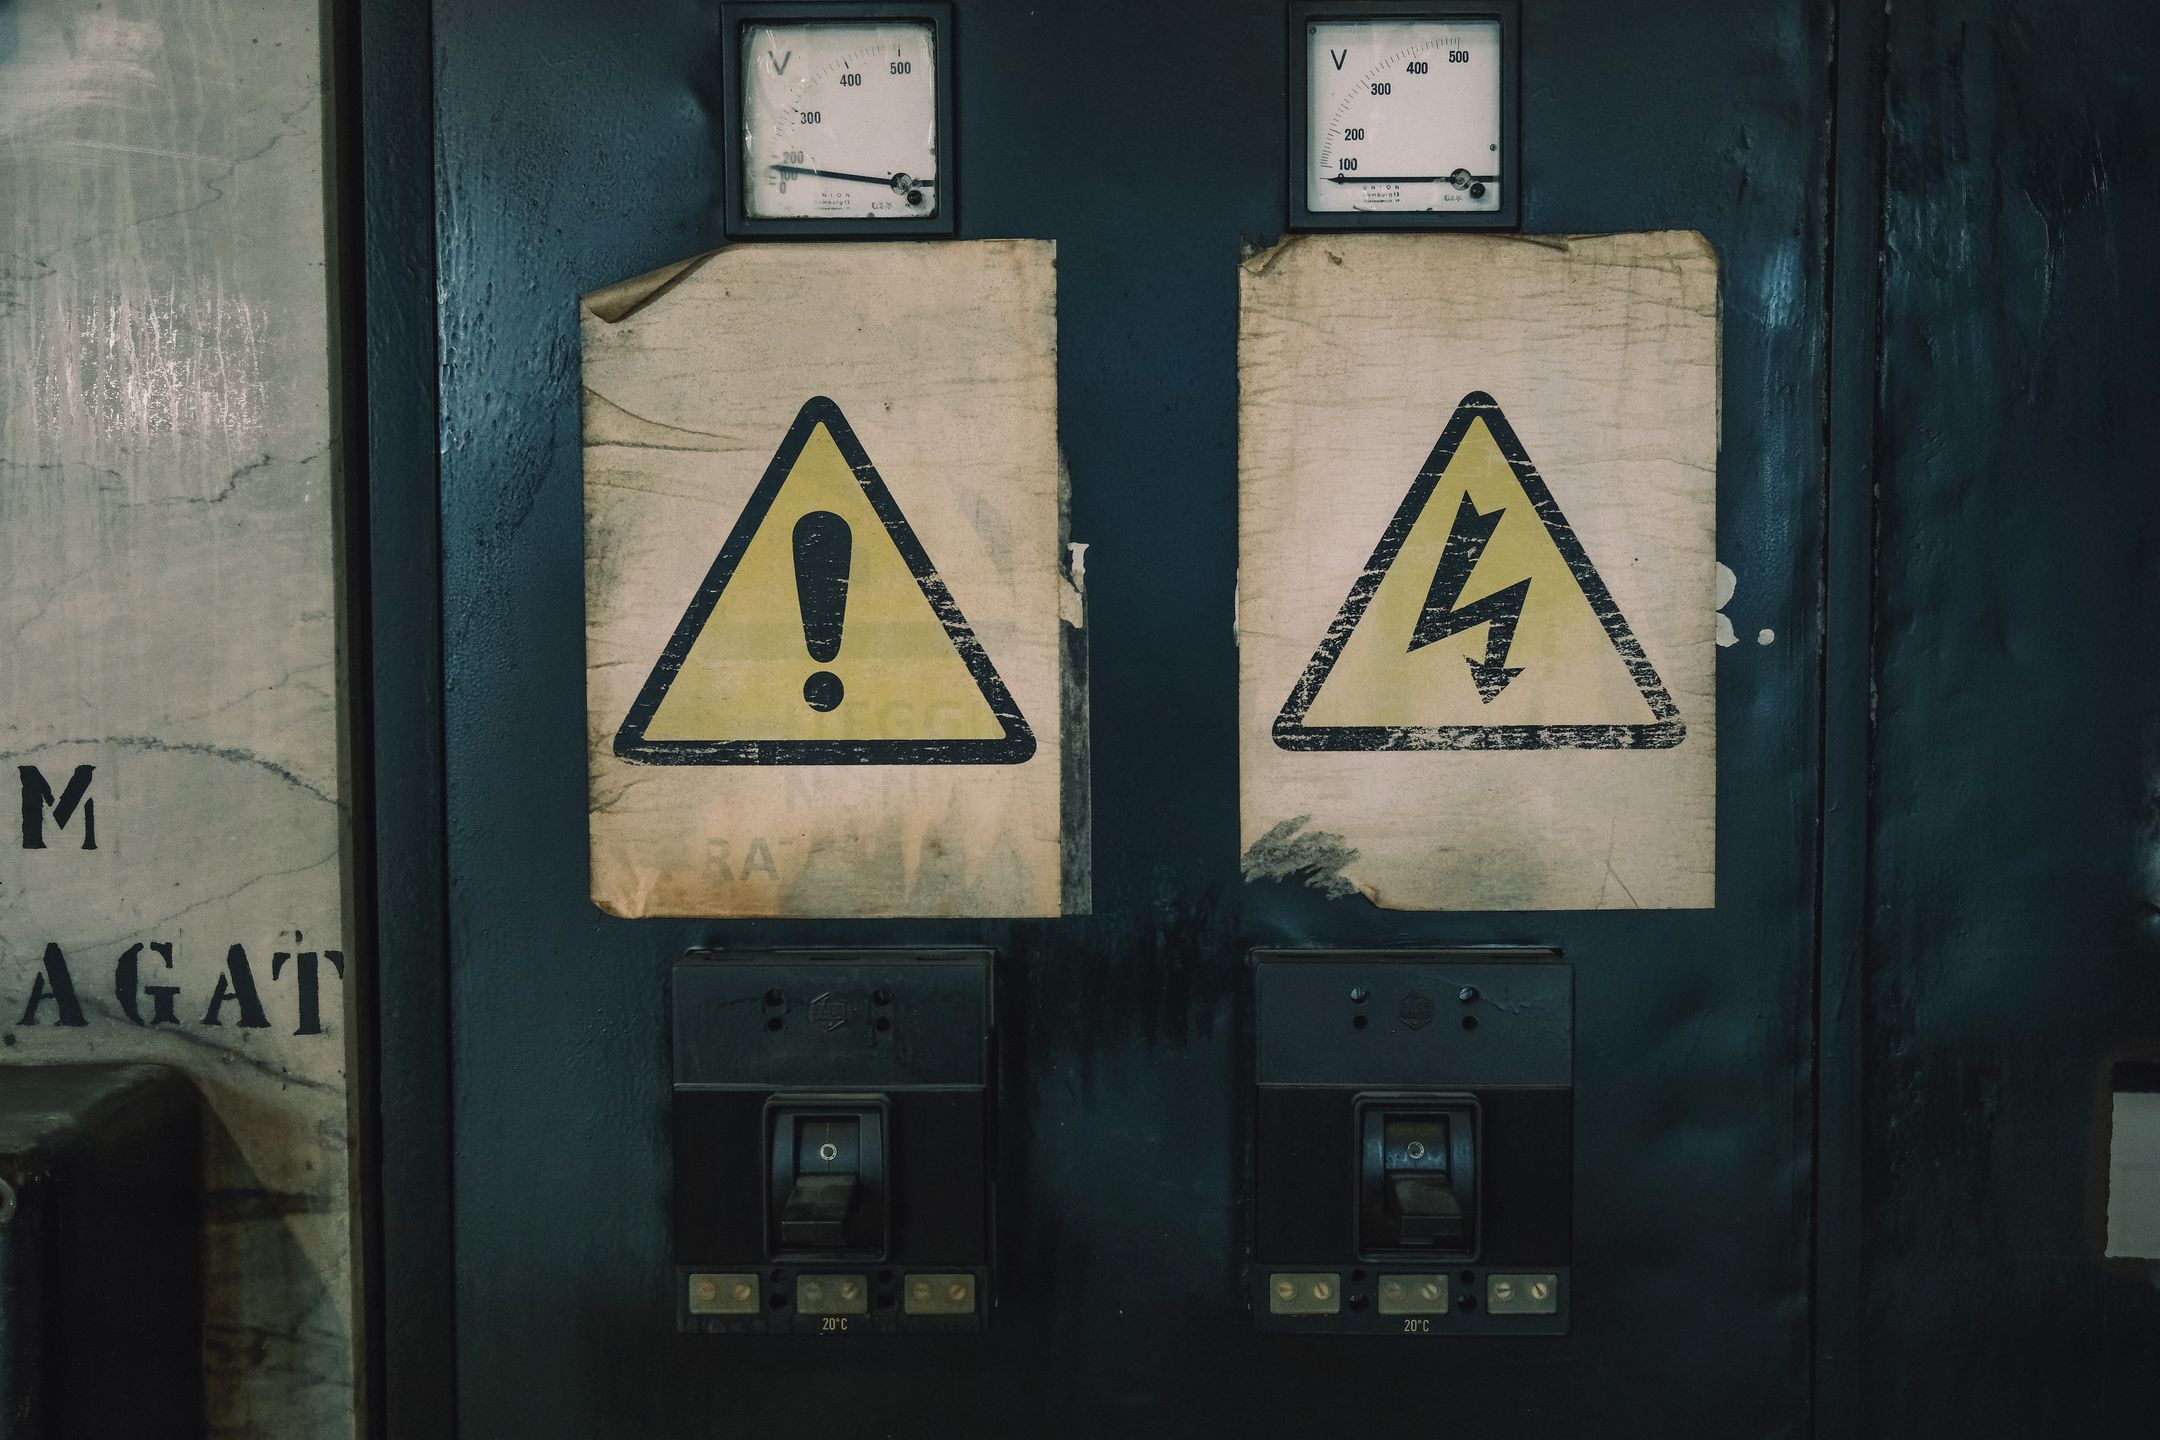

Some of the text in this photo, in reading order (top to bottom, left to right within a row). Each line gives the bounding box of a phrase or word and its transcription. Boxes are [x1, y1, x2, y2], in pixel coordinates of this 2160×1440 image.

[768, 50, 792, 75] V
[1331, 49, 1347, 70] V
[1449, 51, 1469, 63] 500
[890, 62, 911, 74] 500
[1406, 62, 1428, 74] 400
[840, 74, 861, 86] 400
[1371, 83, 1391, 95] 300
[800, 112, 821, 124] 300
[1345, 129, 1364, 141] 200
[783, 151, 803, 164] 200
[1339, 158, 1357, 170] 100
[780, 182, 786, 194] 0
[17, 765, 97, 850] M
[822, 1317, 848, 1330] 20°C
[1404, 1319, 1429, 1332] 20°C
